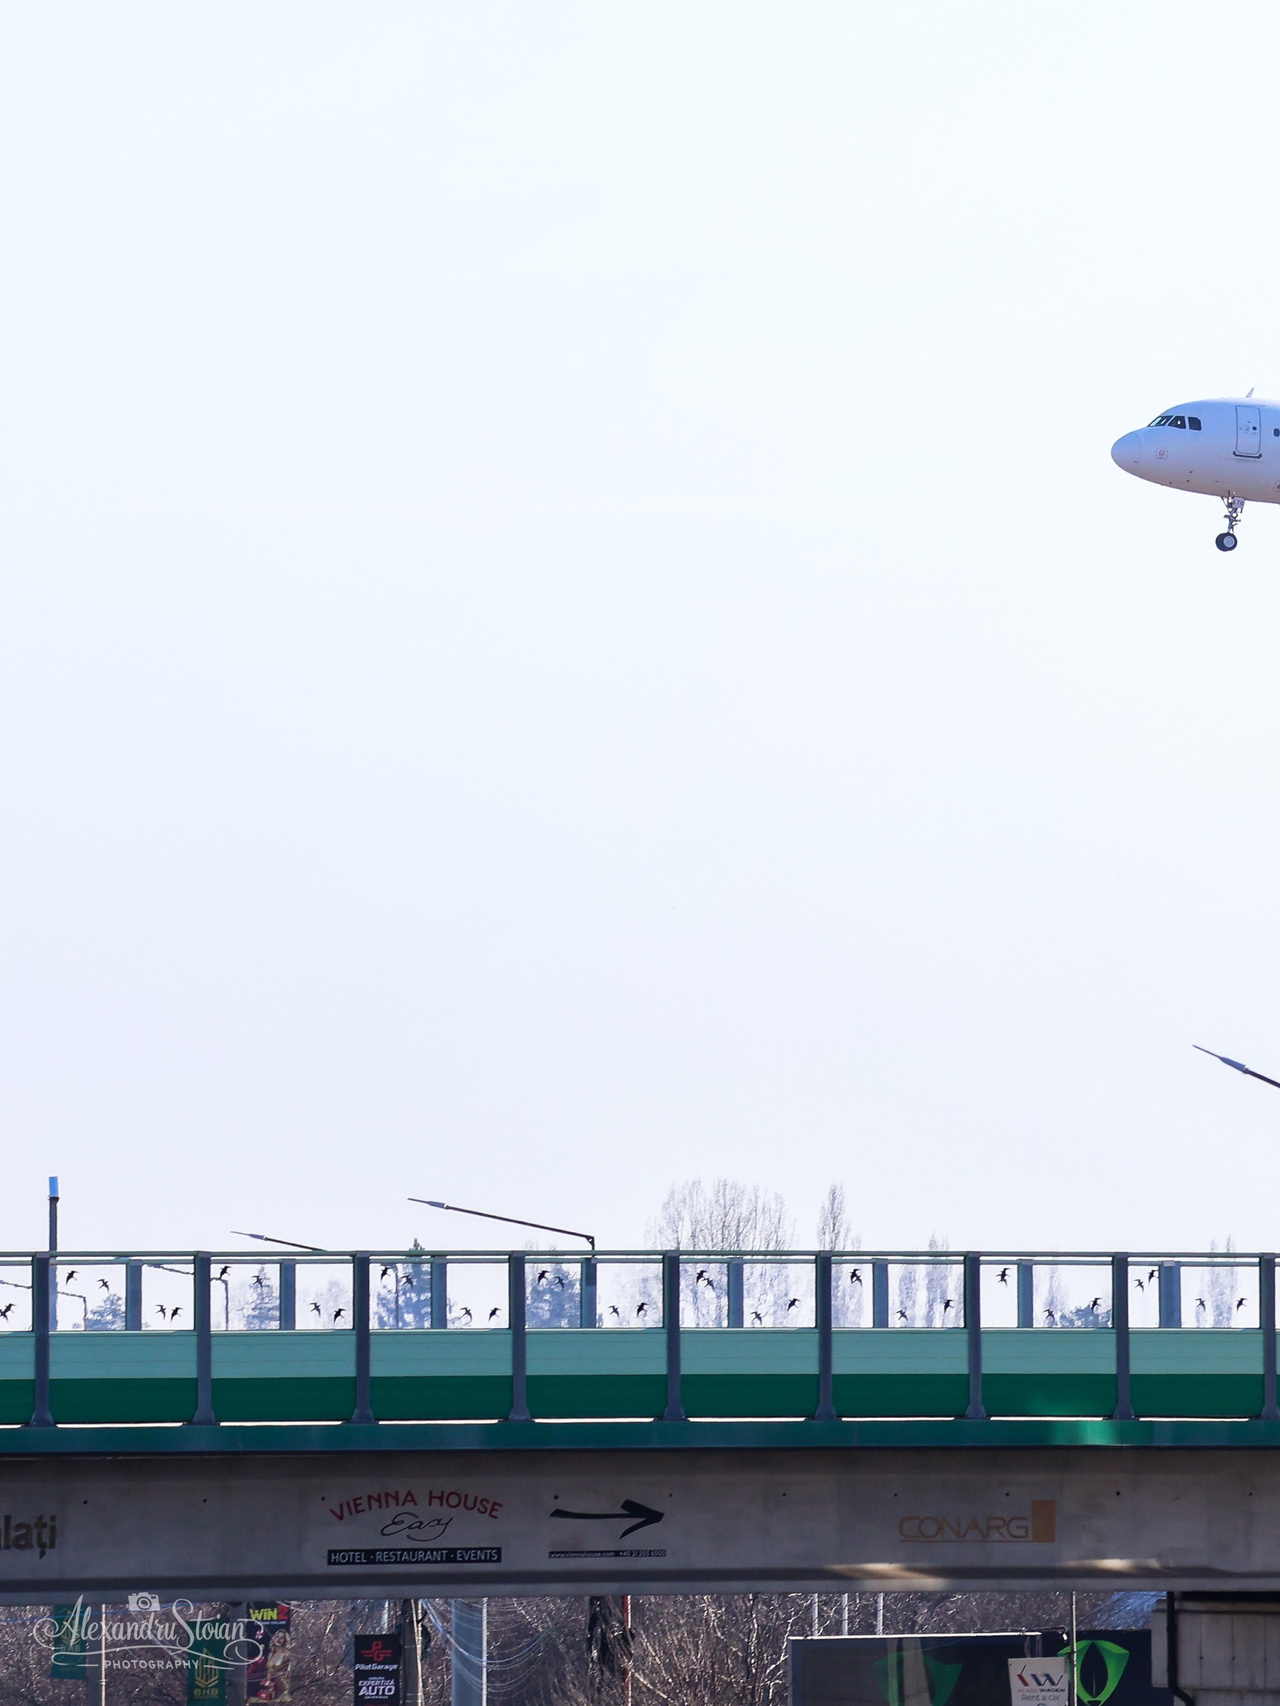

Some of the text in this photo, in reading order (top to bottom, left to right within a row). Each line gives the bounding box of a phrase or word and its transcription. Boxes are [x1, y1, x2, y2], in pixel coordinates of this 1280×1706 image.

[329, 1490, 503, 1521] VIENNA HOUSE
[0, 1514, 57, 1560] lați
[381, 1512, 453, 1542] Easy
[899, 1516, 1029, 1539] CONARG
[331, 1550, 498, 1563] HOTEL RESTAURANT EVENTS
[358, 1685, 396, 1696] AUTO
